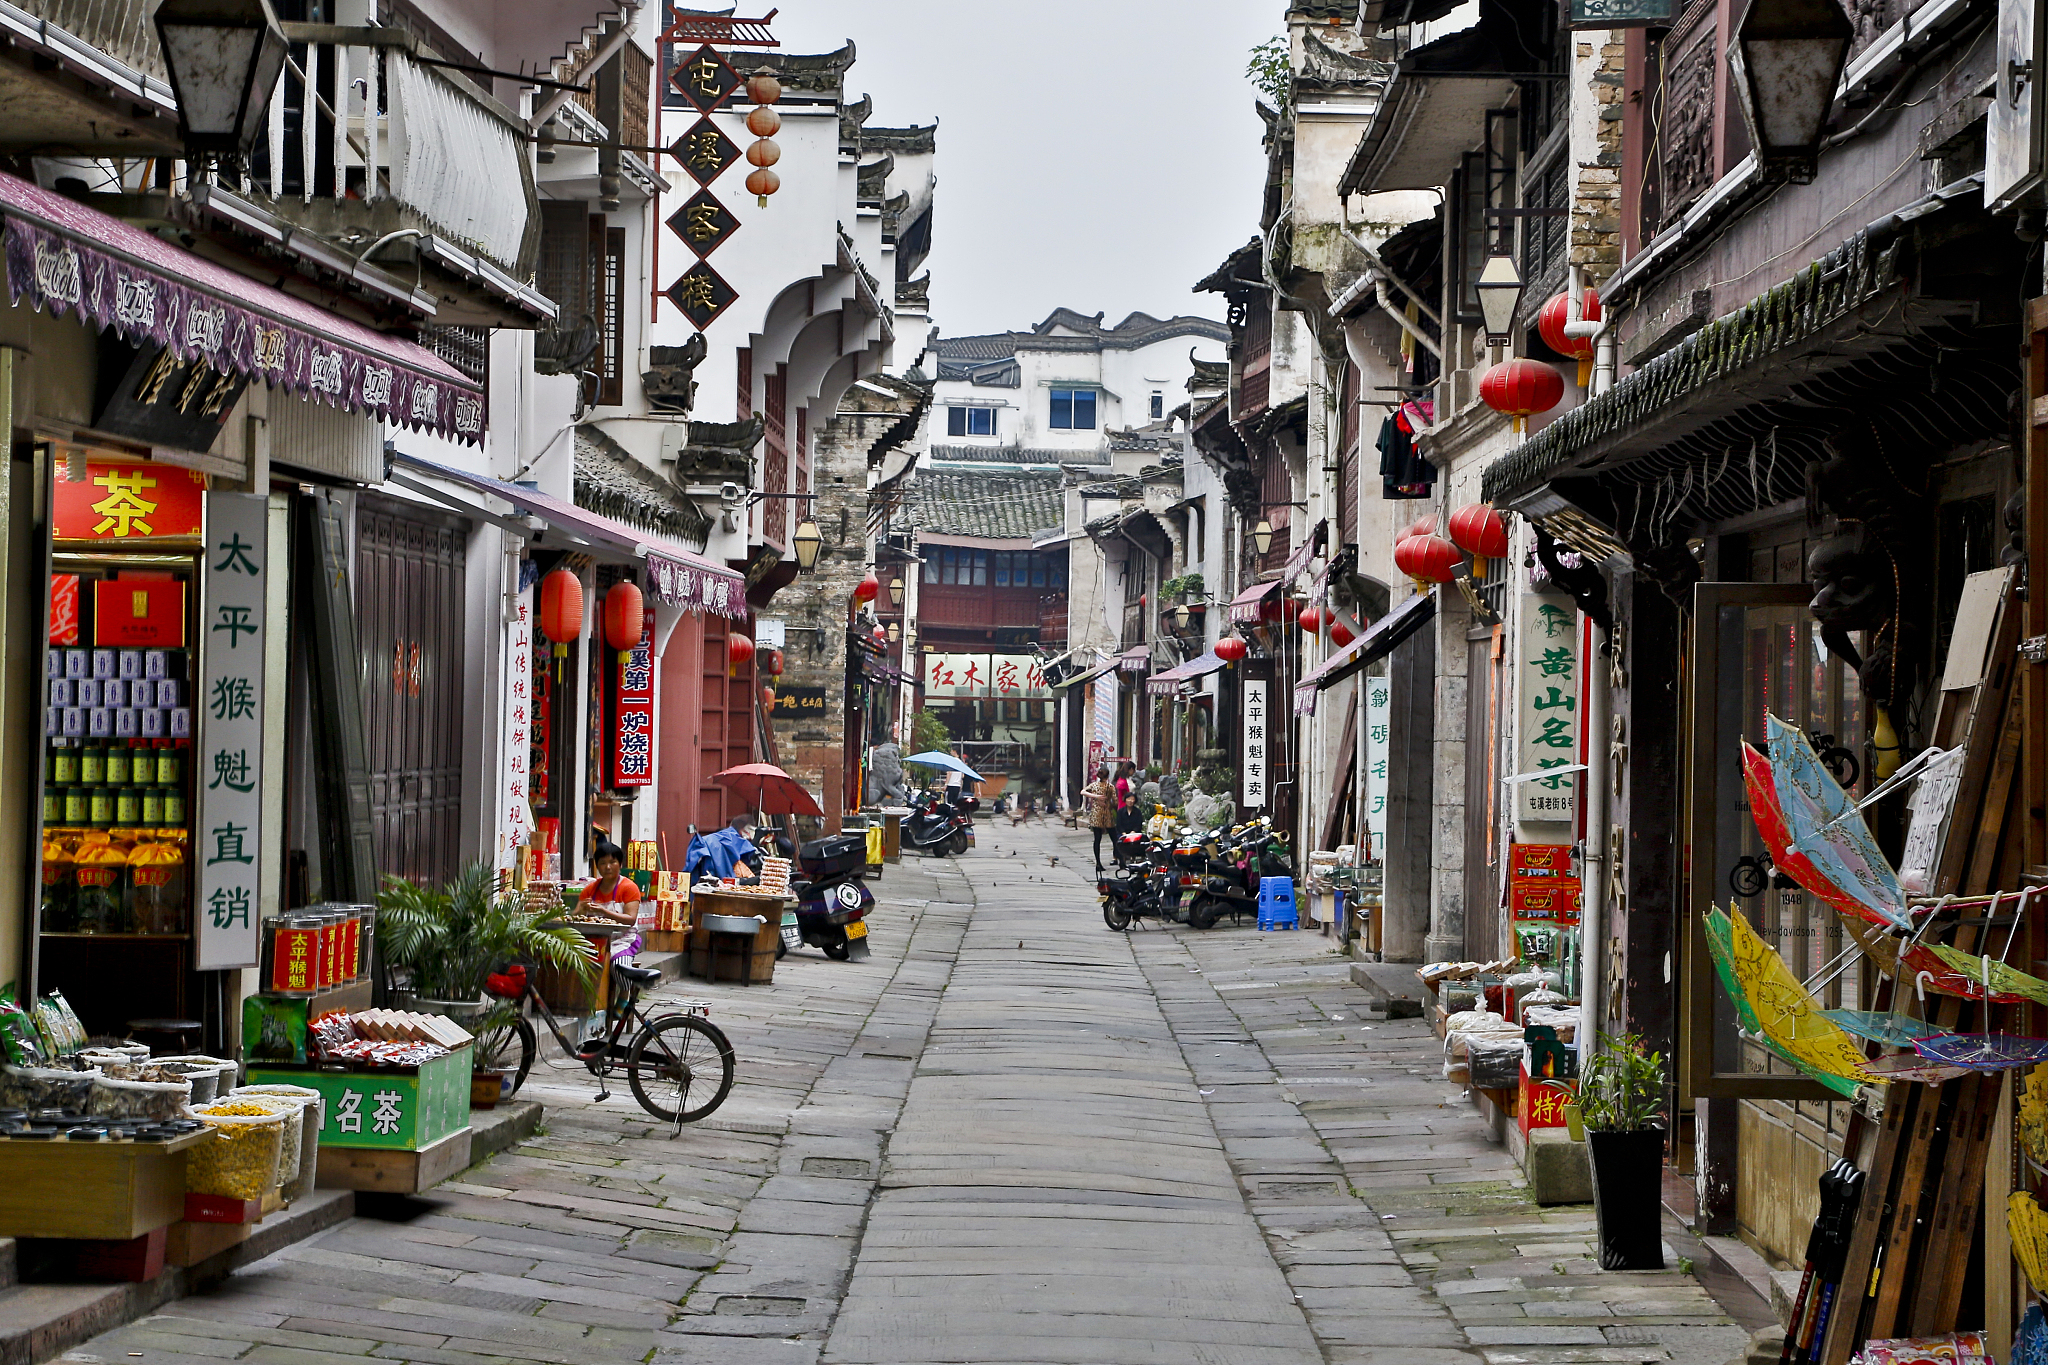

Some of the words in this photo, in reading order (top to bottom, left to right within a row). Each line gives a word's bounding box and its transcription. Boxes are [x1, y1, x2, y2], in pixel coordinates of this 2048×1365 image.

[91, 470, 158, 537] 茶
[207, 532, 260, 930] 太平猴魁直销
[1247, 689, 1263, 797] 太平猴魁专卖
[1529, 646, 1577, 790] 黄山名茶
[1781, 894, 1802, 905] 1948
[288, 932, 308, 989] 太平猴魁
